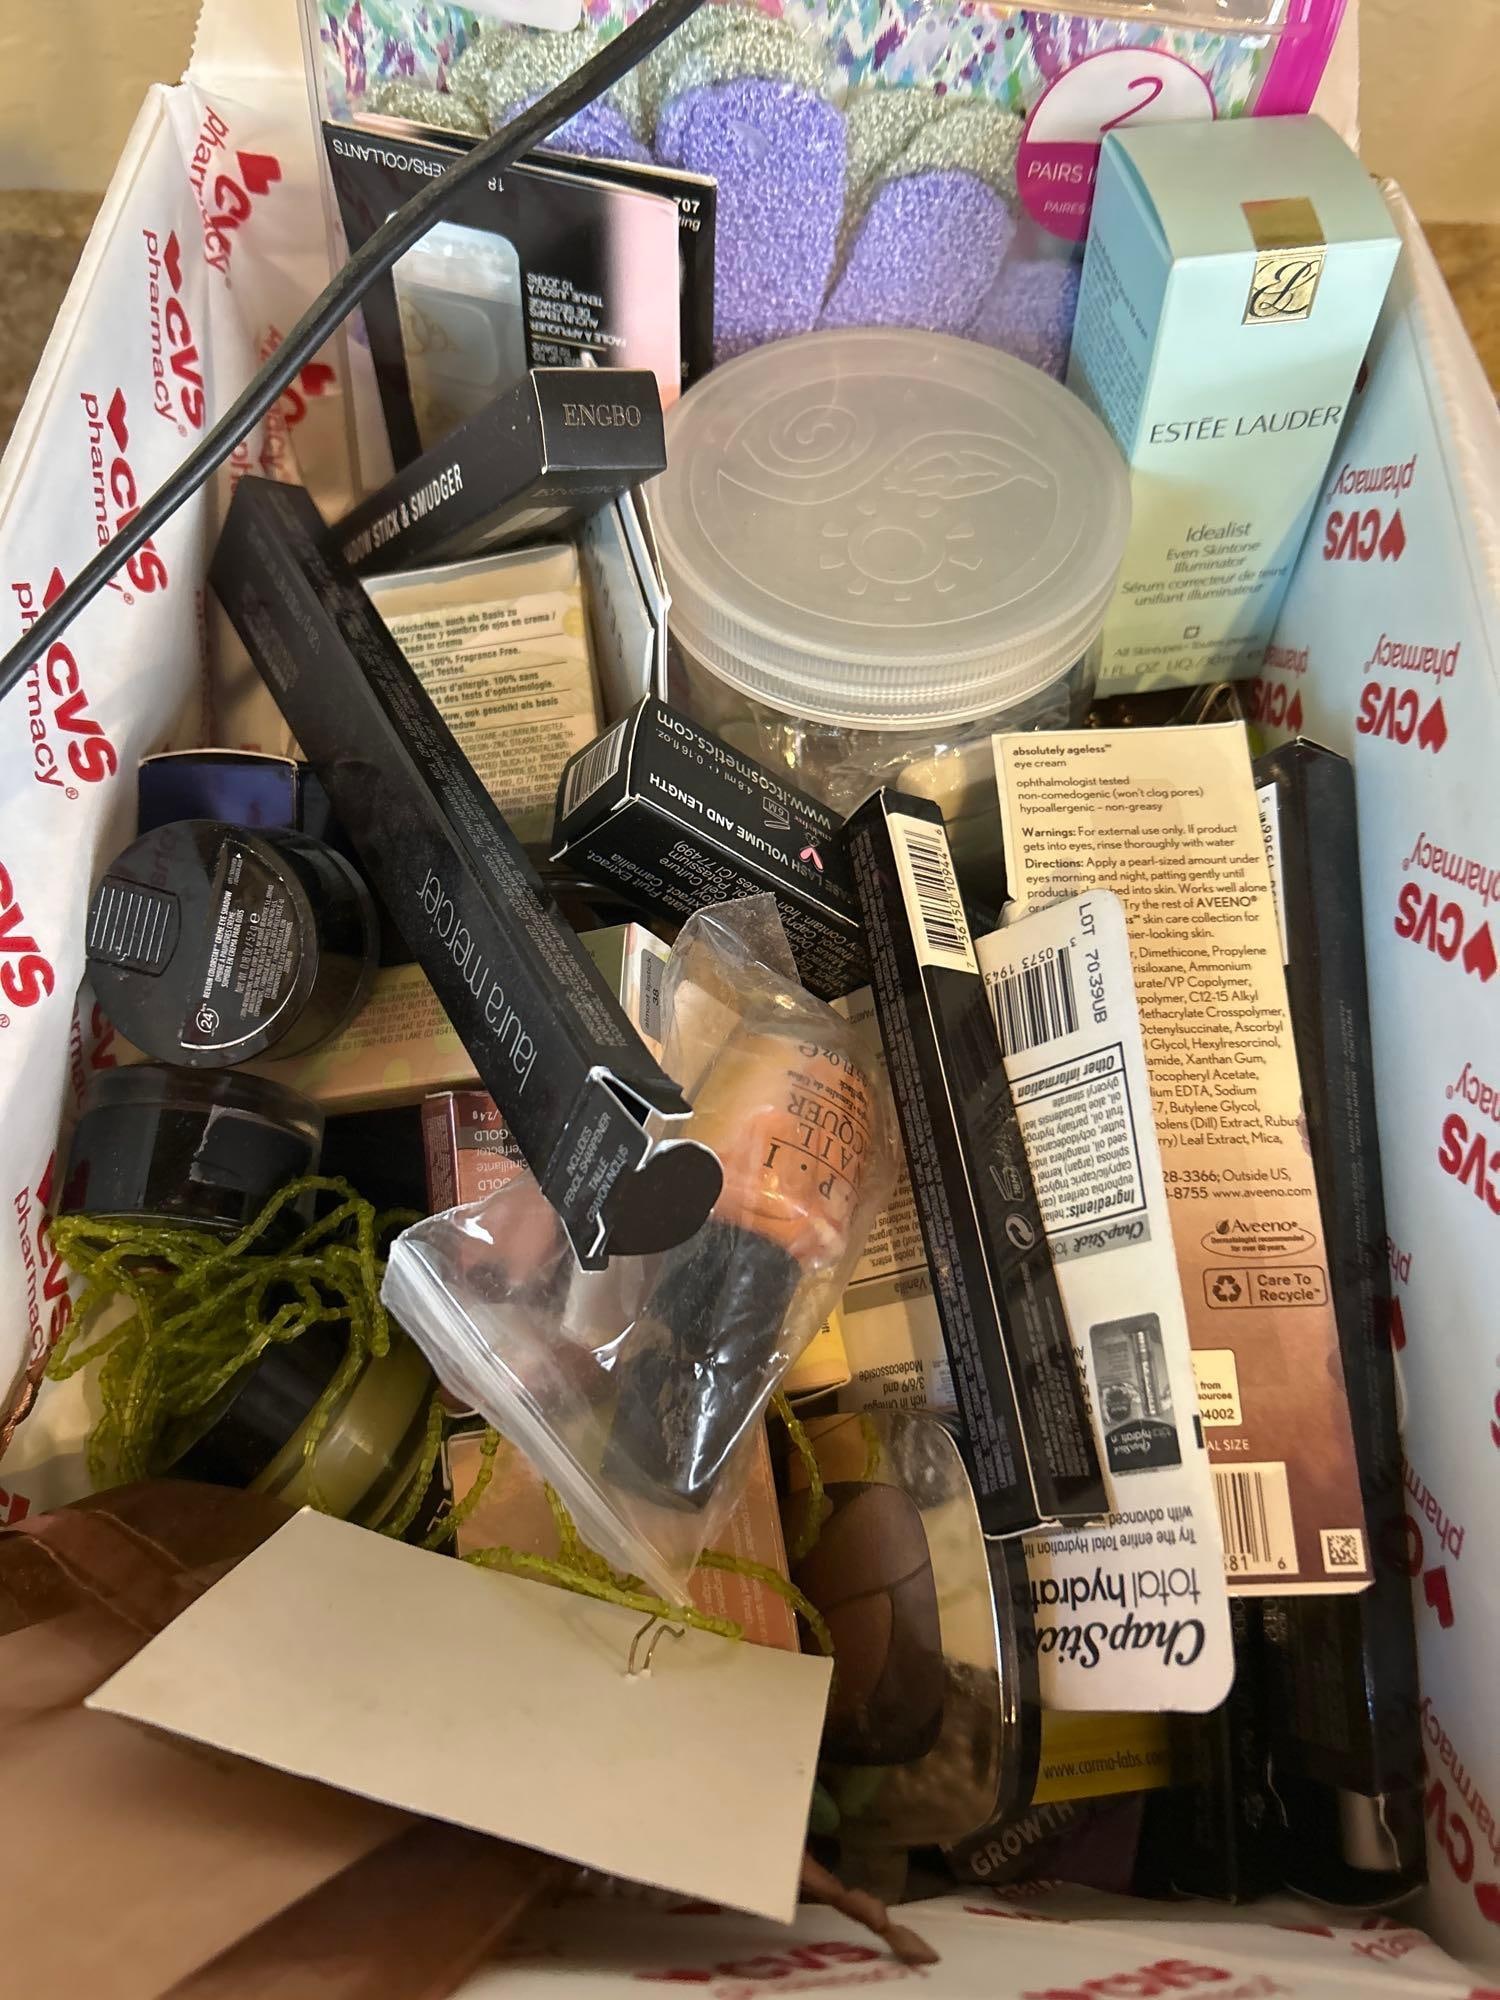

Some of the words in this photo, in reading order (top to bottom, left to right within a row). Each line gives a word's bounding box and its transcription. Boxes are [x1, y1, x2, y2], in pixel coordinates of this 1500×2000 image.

[1028, 160, 1083, 184] PAIRS
[488, 176, 504, 193] 18
[165, 297, 206, 430] CVS
[563, 404, 641, 426] ENGBO
[1235, 406, 1342, 436] LAUDER
[372, 508, 400, 548] STICK
[401, 503, 410, 528] &
[410, 464, 463, 521] SMUDGER
[1186, 522, 1251, 542] Idealist
[1323, 508, 1381, 561] CVS
[1166, 549, 1200, 561] Even
[1202, 541, 1261, 556] Skintone
[1174, 558, 1246, 574] Illuminator
[1122, 580, 1165, 594] Sérum
[1168, 572, 1235, 590] correcteur
[1134, 591, 1183, 606] unifiant
[1186, 583, 1264, 600] illuminateur
[455, 651, 498, 666] Fragrance
[500, 647, 521, 657] Free.
[47, 642, 118, 782] CVS
[1357, 682, 1419, 744] CVS
[681, 747, 704, 764] 0.16
[1012, 746, 1065, 757] absolutely
[657, 710, 832, 830] www.itcosmetics.com
[1014, 760, 1032, 769] eye
[1034, 759, 1067, 767] cream
[1017, 777, 1096, 788] ophthalmologist
[1099, 777, 1130, 786] tested
[650, 772, 703, 815] LENGTH
[1018, 790, 1111, 801] non-comedogenic
[1112, 788, 1146, 799] (won't
[1147, 788, 1168, 799] clog
[1171, 787, 1204, 799] pores)
[1020, 802, 1095, 814] hypoallergenic
[1105, 802, 1163, 813] non-greasy
[707, 809, 734, 830] AND
[1022, 827, 1076, 839] Warnings:
[1078, 827, 1095, 836] For
[1098, 826, 1140, 835] external
[1142, 827, 1159, 835] use
[1160, 826, 1186, 837] only.
[1188, 825, 1195, 834] If
[1197, 825, 1237, 836] product
[673, 841, 717, 869] 77499)
[736, 825, 790, 866] VOLUME
[1024, 842, 1045, 853] gets
[1047, 841, 1067, 851] into
[1069, 841, 1095, 853] eyes,
[1097, 840, 1122, 849] rinse
[1124, 839, 1179, 851] thoroughly
[1182, 839, 1203, 848] with
[1205, 839, 1235, 848] water
[587, 850, 633, 882] Extract,
[611, 853, 662, 887] Camellia
[659, 858, 702, 886] Culture
[668, 851, 731, 889] Potassium
[1025, 859, 1084, 869] Directions:
[1086, 857, 1117, 869] Apply
[1129, 855, 1186, 868] pearl-sized
[1188, 856, 1227, 865] amount
[1230, 855, 1260, 864] under
[1026, 874, 1050, 885] eyes
[1052, 873, 1096, 885] morning
[1099, 872, 1118, 882] and
[1120, 871, 1148, 883] night,
[1150, 871, 1187, 883] patting
[1188, 870, 1220, 882] gently
[1222, 869, 1245, 878] until
[633, 878, 662, 898] Fruit
[700, 884, 727, 900] Cell
[950, 900, 969, 943] 36150
[1079, 902, 1096, 936] LOT
[1394, 882, 1464, 962] CVS
[416, 868, 492, 999] mercier
[203, 978, 213, 999] REVLON
[221, 890, 232, 914] SHADOW
[1140, 947, 1210, 959] Dimethicone,
[1212, 946, 1266, 958] Propylene
[201, 1013, 214, 1029] 24
[484, 982, 538, 1096] laura
[1083, 1056, 1115, 1074] Other
[1017, 1067, 1080, 1097] information
[1150, 1070, 1210, 1082] Tocopheryl
[1213, 1069, 1259, 1081] Acetate,
[475, 1128, 508, 1141] GOLD
[1098, 1119, 1126, 1132] butter,
[1096, 1146, 1129, 1163] spinosa
[1037, 1165, 1062, 1181] kernel
[1064, 1155, 1094, 1175] (argan)
[1223, 1169, 1268, 1182] Outside
[1271, 1168, 1291, 1181] US,
[1212, 1186, 1312, 1199] www.aveeno.com
[1068, 1189, 1135, 1217] Ingredients:
[1074, 1221, 1144, 1251] ChapStick
[894, 1276, 928, 1294] Vanilla
[1257, 1274, 1290, 1286] Care
[1295, 1273, 1311, 1284] To
[859, 1360, 923, 1381] Madecassoside
[883, 1381, 899, 1394] and
[903, 1376, 925, 1392] 3/6/9
[1223, 1439, 1249, 1450] SIZE
[1109, 1508, 1164, 1529] advanced
[1170, 1504, 1193, 1522] with
[1038, 1537, 1090, 1555] Hydration
[1091, 1534, 1118, 1551] Total
[1120, 1530, 1154, 1547] entire
[1156, 1530, 1175, 1544] the
[1178, 1528, 1196, 1544] Try
[1133, 1567, 1200, 1608] total
[970, 1802, 1074, 1876] GROWTH
